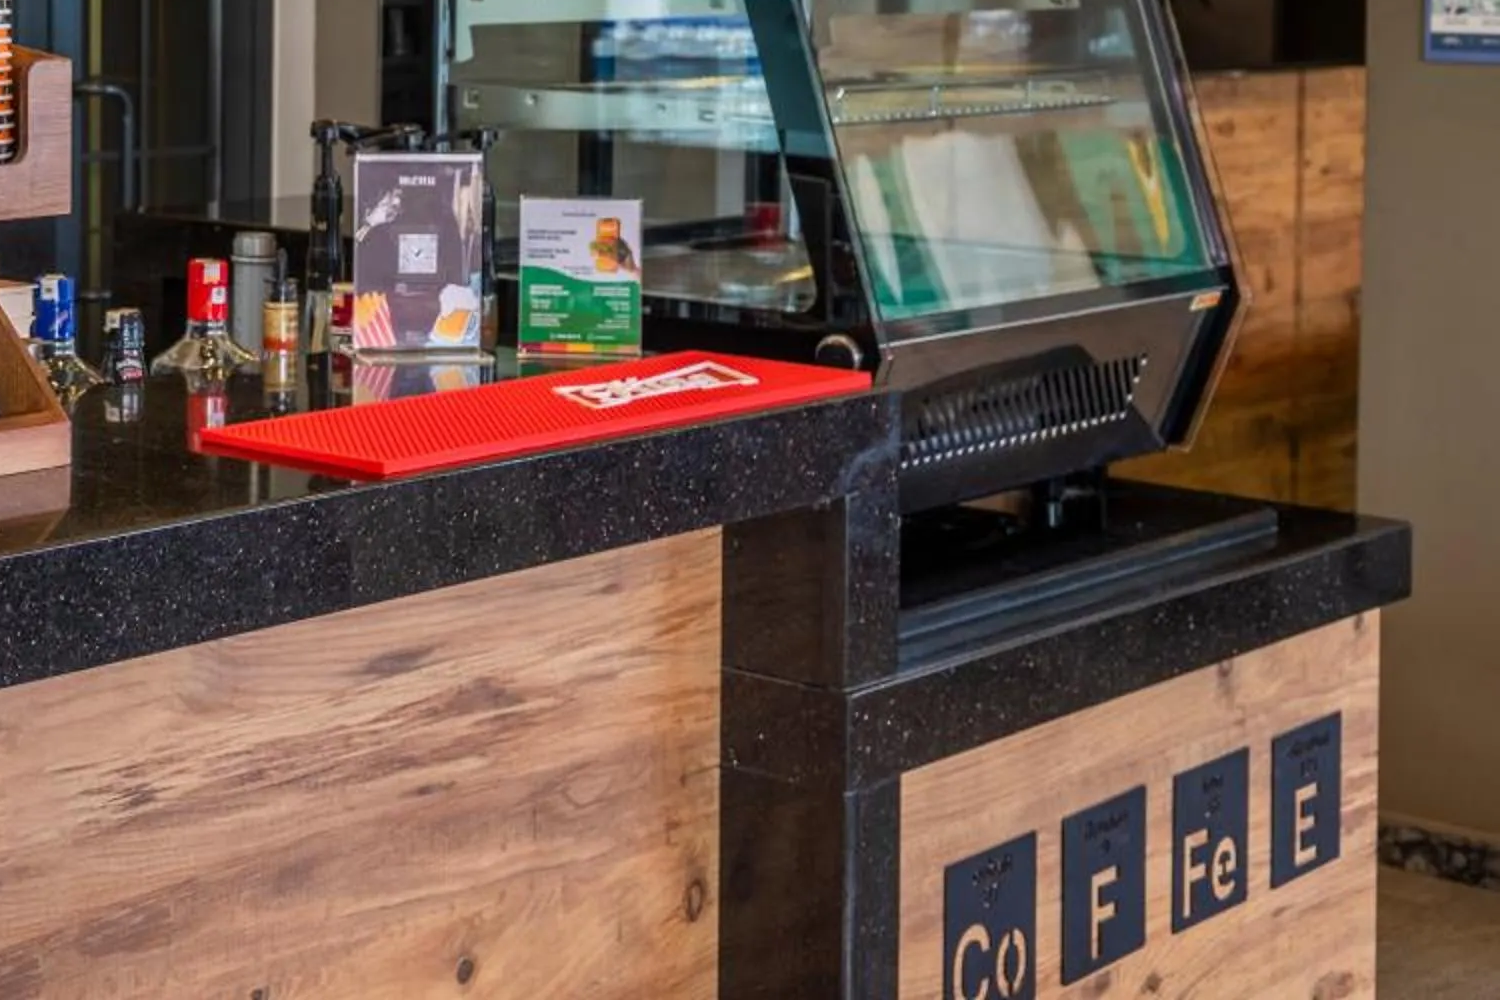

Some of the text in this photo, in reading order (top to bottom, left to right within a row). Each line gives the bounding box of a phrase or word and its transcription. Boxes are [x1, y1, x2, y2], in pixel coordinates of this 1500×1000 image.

[1091, 864, 1118, 960] F
[1182, 828, 1238, 918] Fe
[1294, 782, 1319, 868] E
